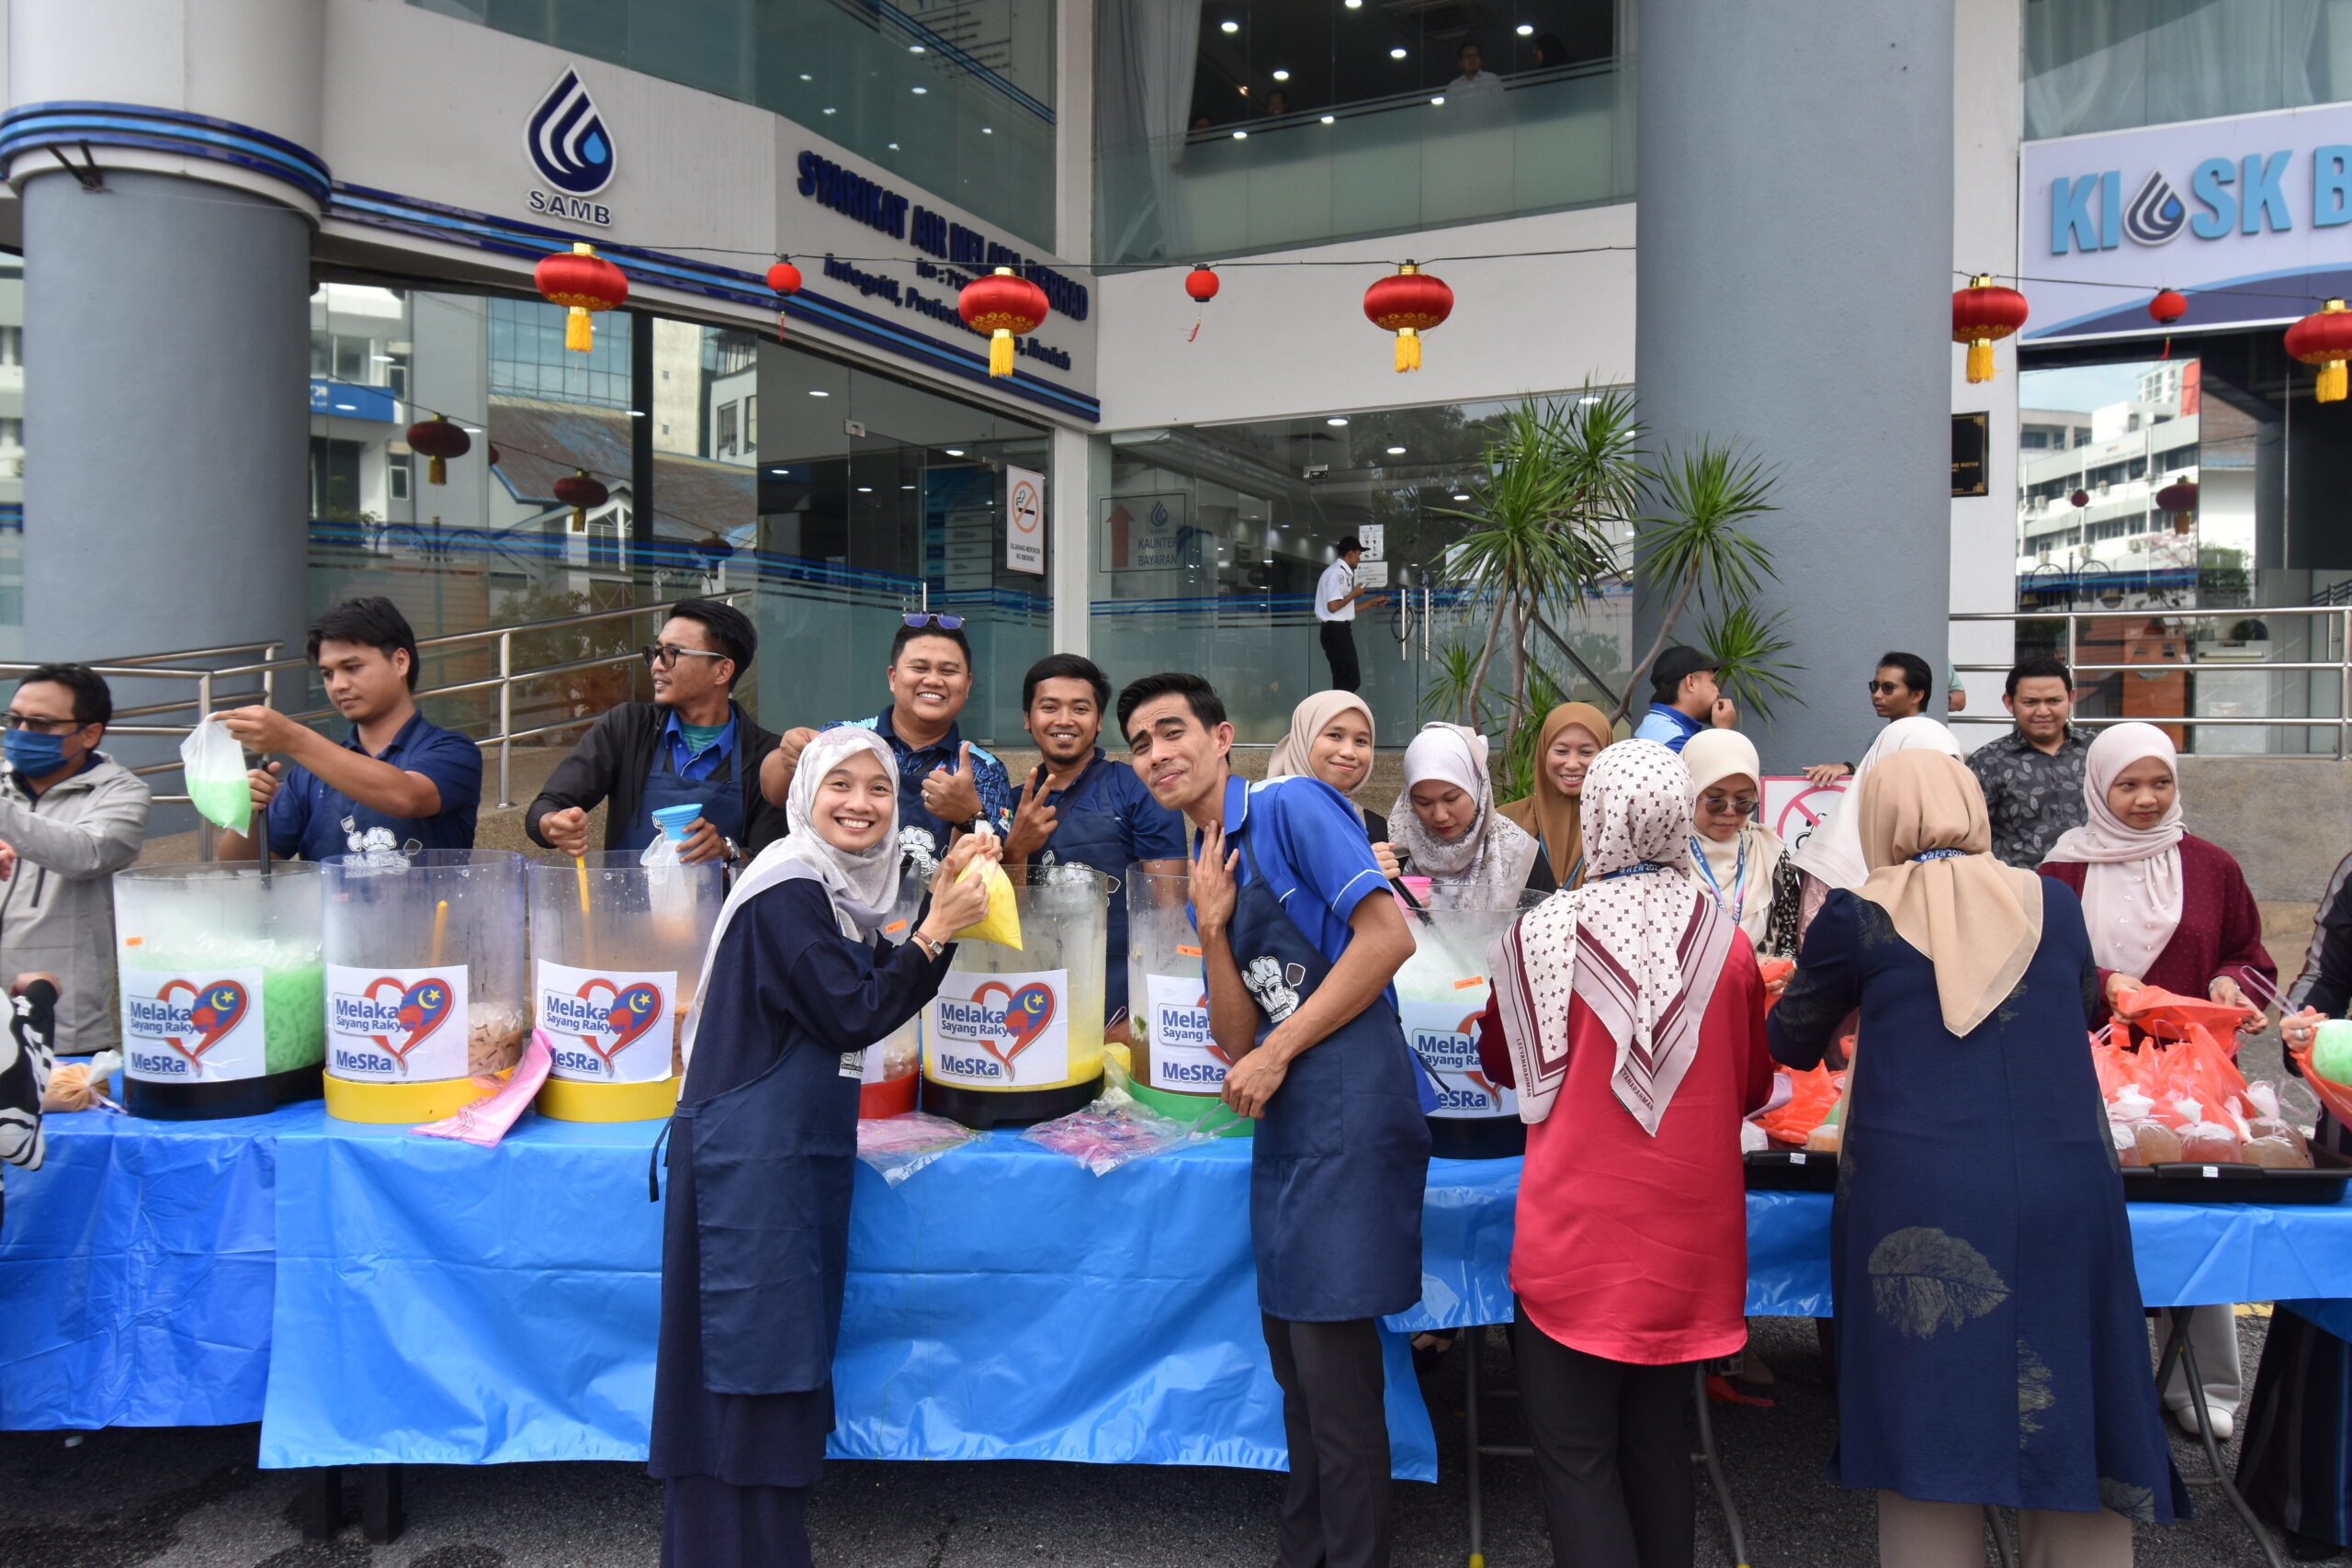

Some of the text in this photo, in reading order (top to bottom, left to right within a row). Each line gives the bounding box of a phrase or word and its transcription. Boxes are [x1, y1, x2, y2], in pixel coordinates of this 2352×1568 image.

[528, 189, 612, 226] SAMB
[797, 150, 909, 240] SYARIKAT
[910, 204, 948, 260] AIR
[823, 253, 902, 307] Integriti,
[1026, 337, 1071, 370] Ibadah
[1137, 553, 1177, 567] BAYARAN
[130, 1000, 194, 1021] Melaka
[335, 998, 401, 1020] Melaka
[547, 995, 612, 1021] Melaka
[941, 1002, 1007, 1023] Melaka
[130, 1018, 163, 1034] Sayang
[336, 1016, 369, 1032] Sayang
[547, 1012, 580, 1031] Sayang
[942, 1020, 977, 1037] Sayang
[1162, 1009, 1209, 1029] Mela
[1163, 1027, 1204, 1043] Sayang
[1418, 1034, 1479, 1055] Melak
[131, 1052, 187, 1073] MeSRa
[335, 1049, 392, 1071] MeSRa
[941, 1054, 1000, 1076] MeSRa
[1516, 1037, 1532, 1098] LEEYANARAHMAN
[1162, 1061, 1227, 1082] MeSRa
[1437, 1089, 1487, 1109] eSRa
[1619, 1066, 1655, 1111] EYANARAHMAN
